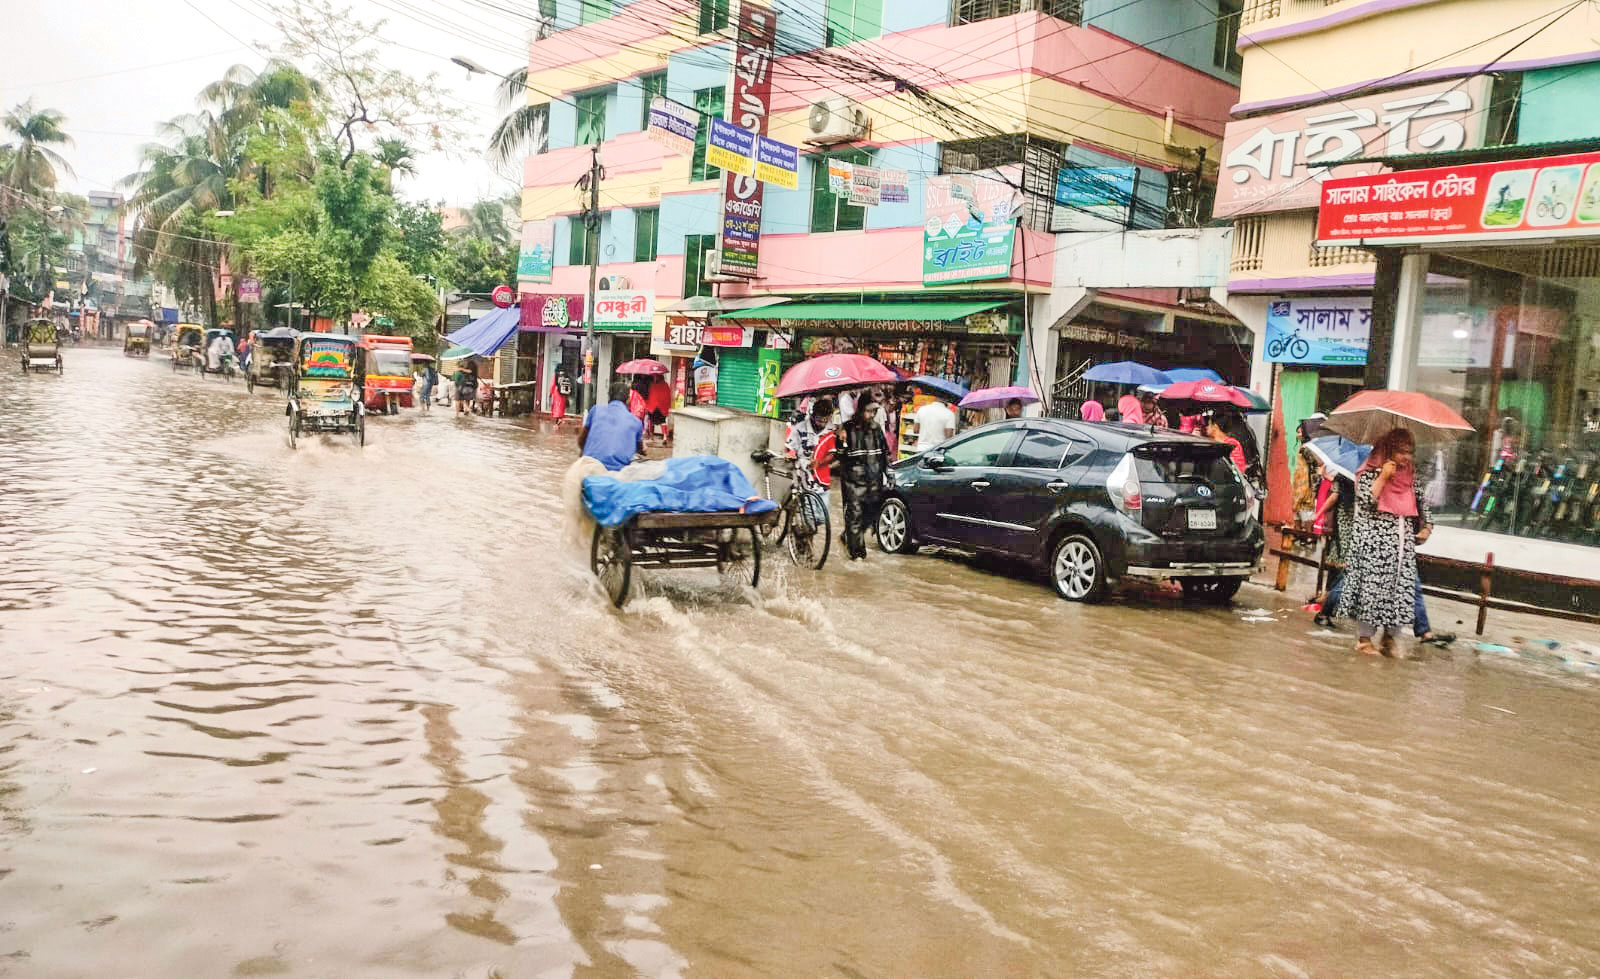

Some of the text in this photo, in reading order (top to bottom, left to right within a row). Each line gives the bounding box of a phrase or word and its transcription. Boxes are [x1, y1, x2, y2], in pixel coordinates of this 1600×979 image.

[1326, 186, 1370, 205] সালাম
[1372, 178, 1429, 203] সাইকেল
[1432, 173, 1477, 197] স্টোর
[596, 296, 646, 318] সেঞ্চুরী
[1296, 306, 1354, 331] সালাম
